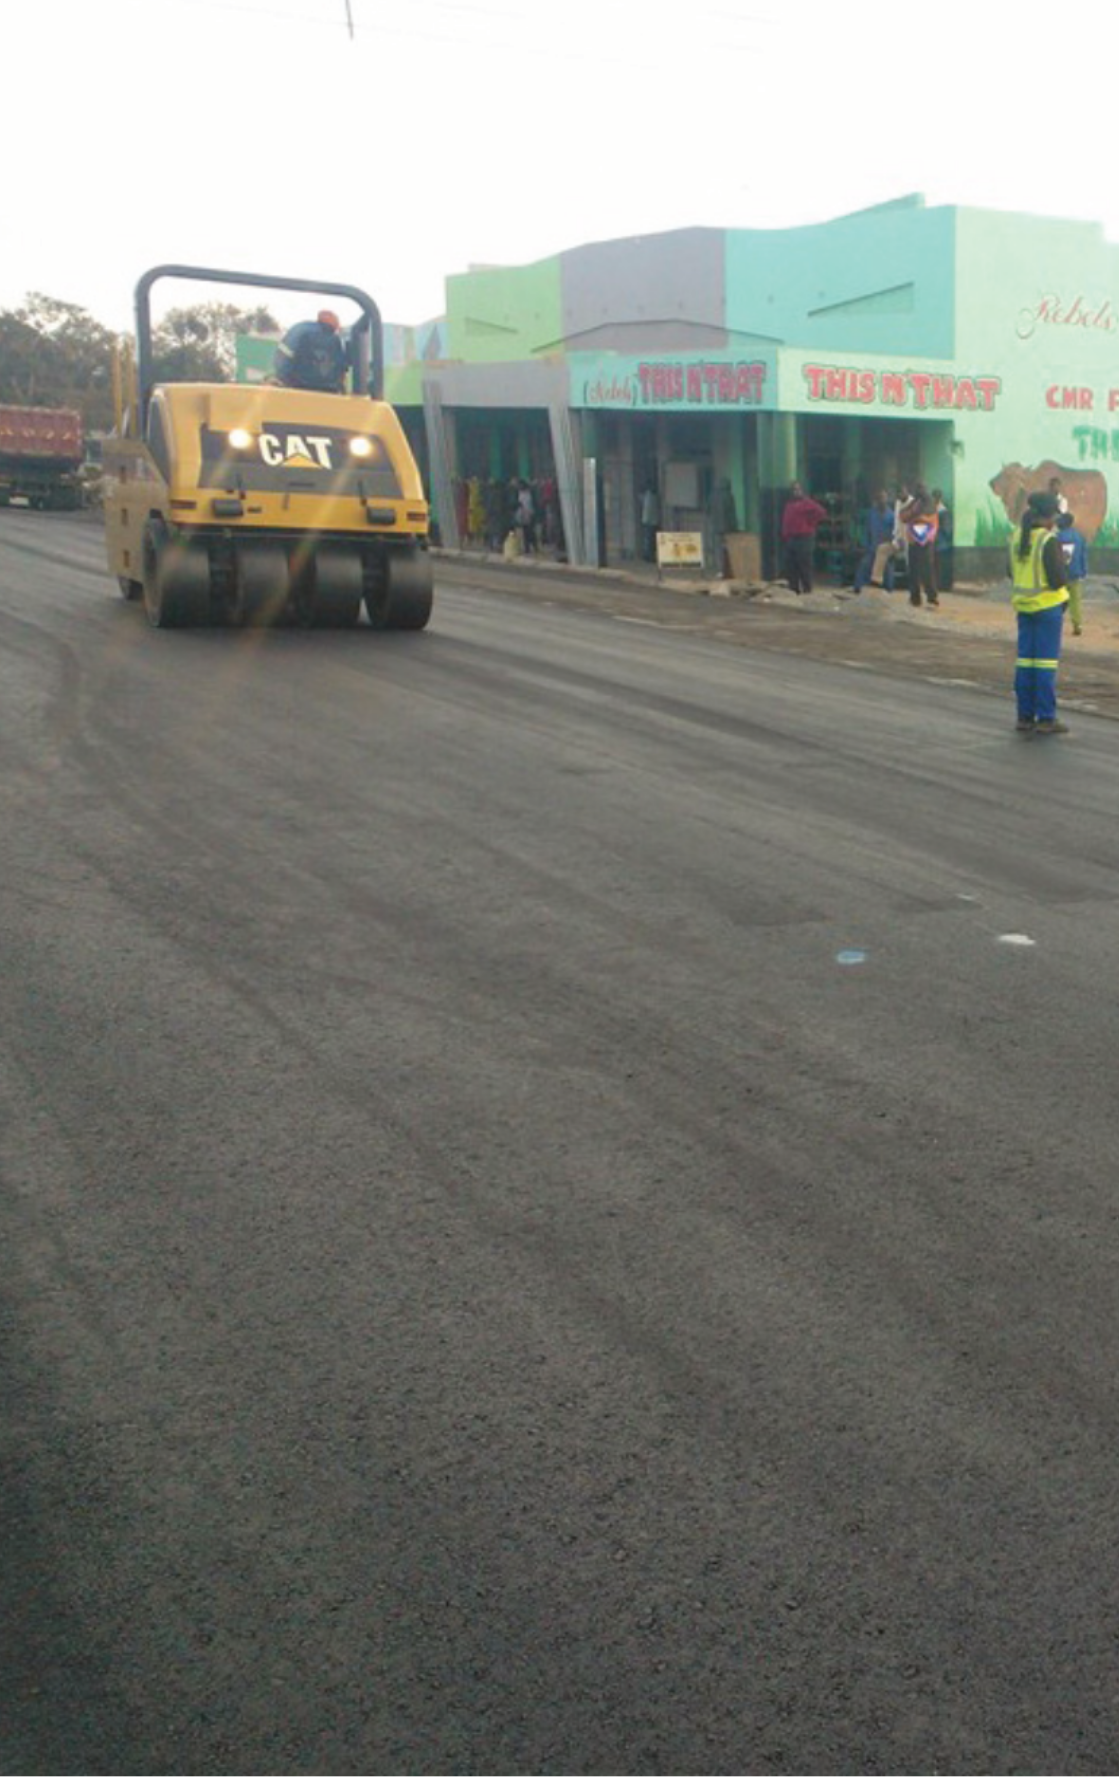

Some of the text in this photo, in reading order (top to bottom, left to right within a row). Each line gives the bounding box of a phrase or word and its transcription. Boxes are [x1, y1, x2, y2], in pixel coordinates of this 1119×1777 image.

[803, 363, 875, 404] THIS
[1046, 384, 1093, 411] CMR
[258, 433, 332, 469] CAT
